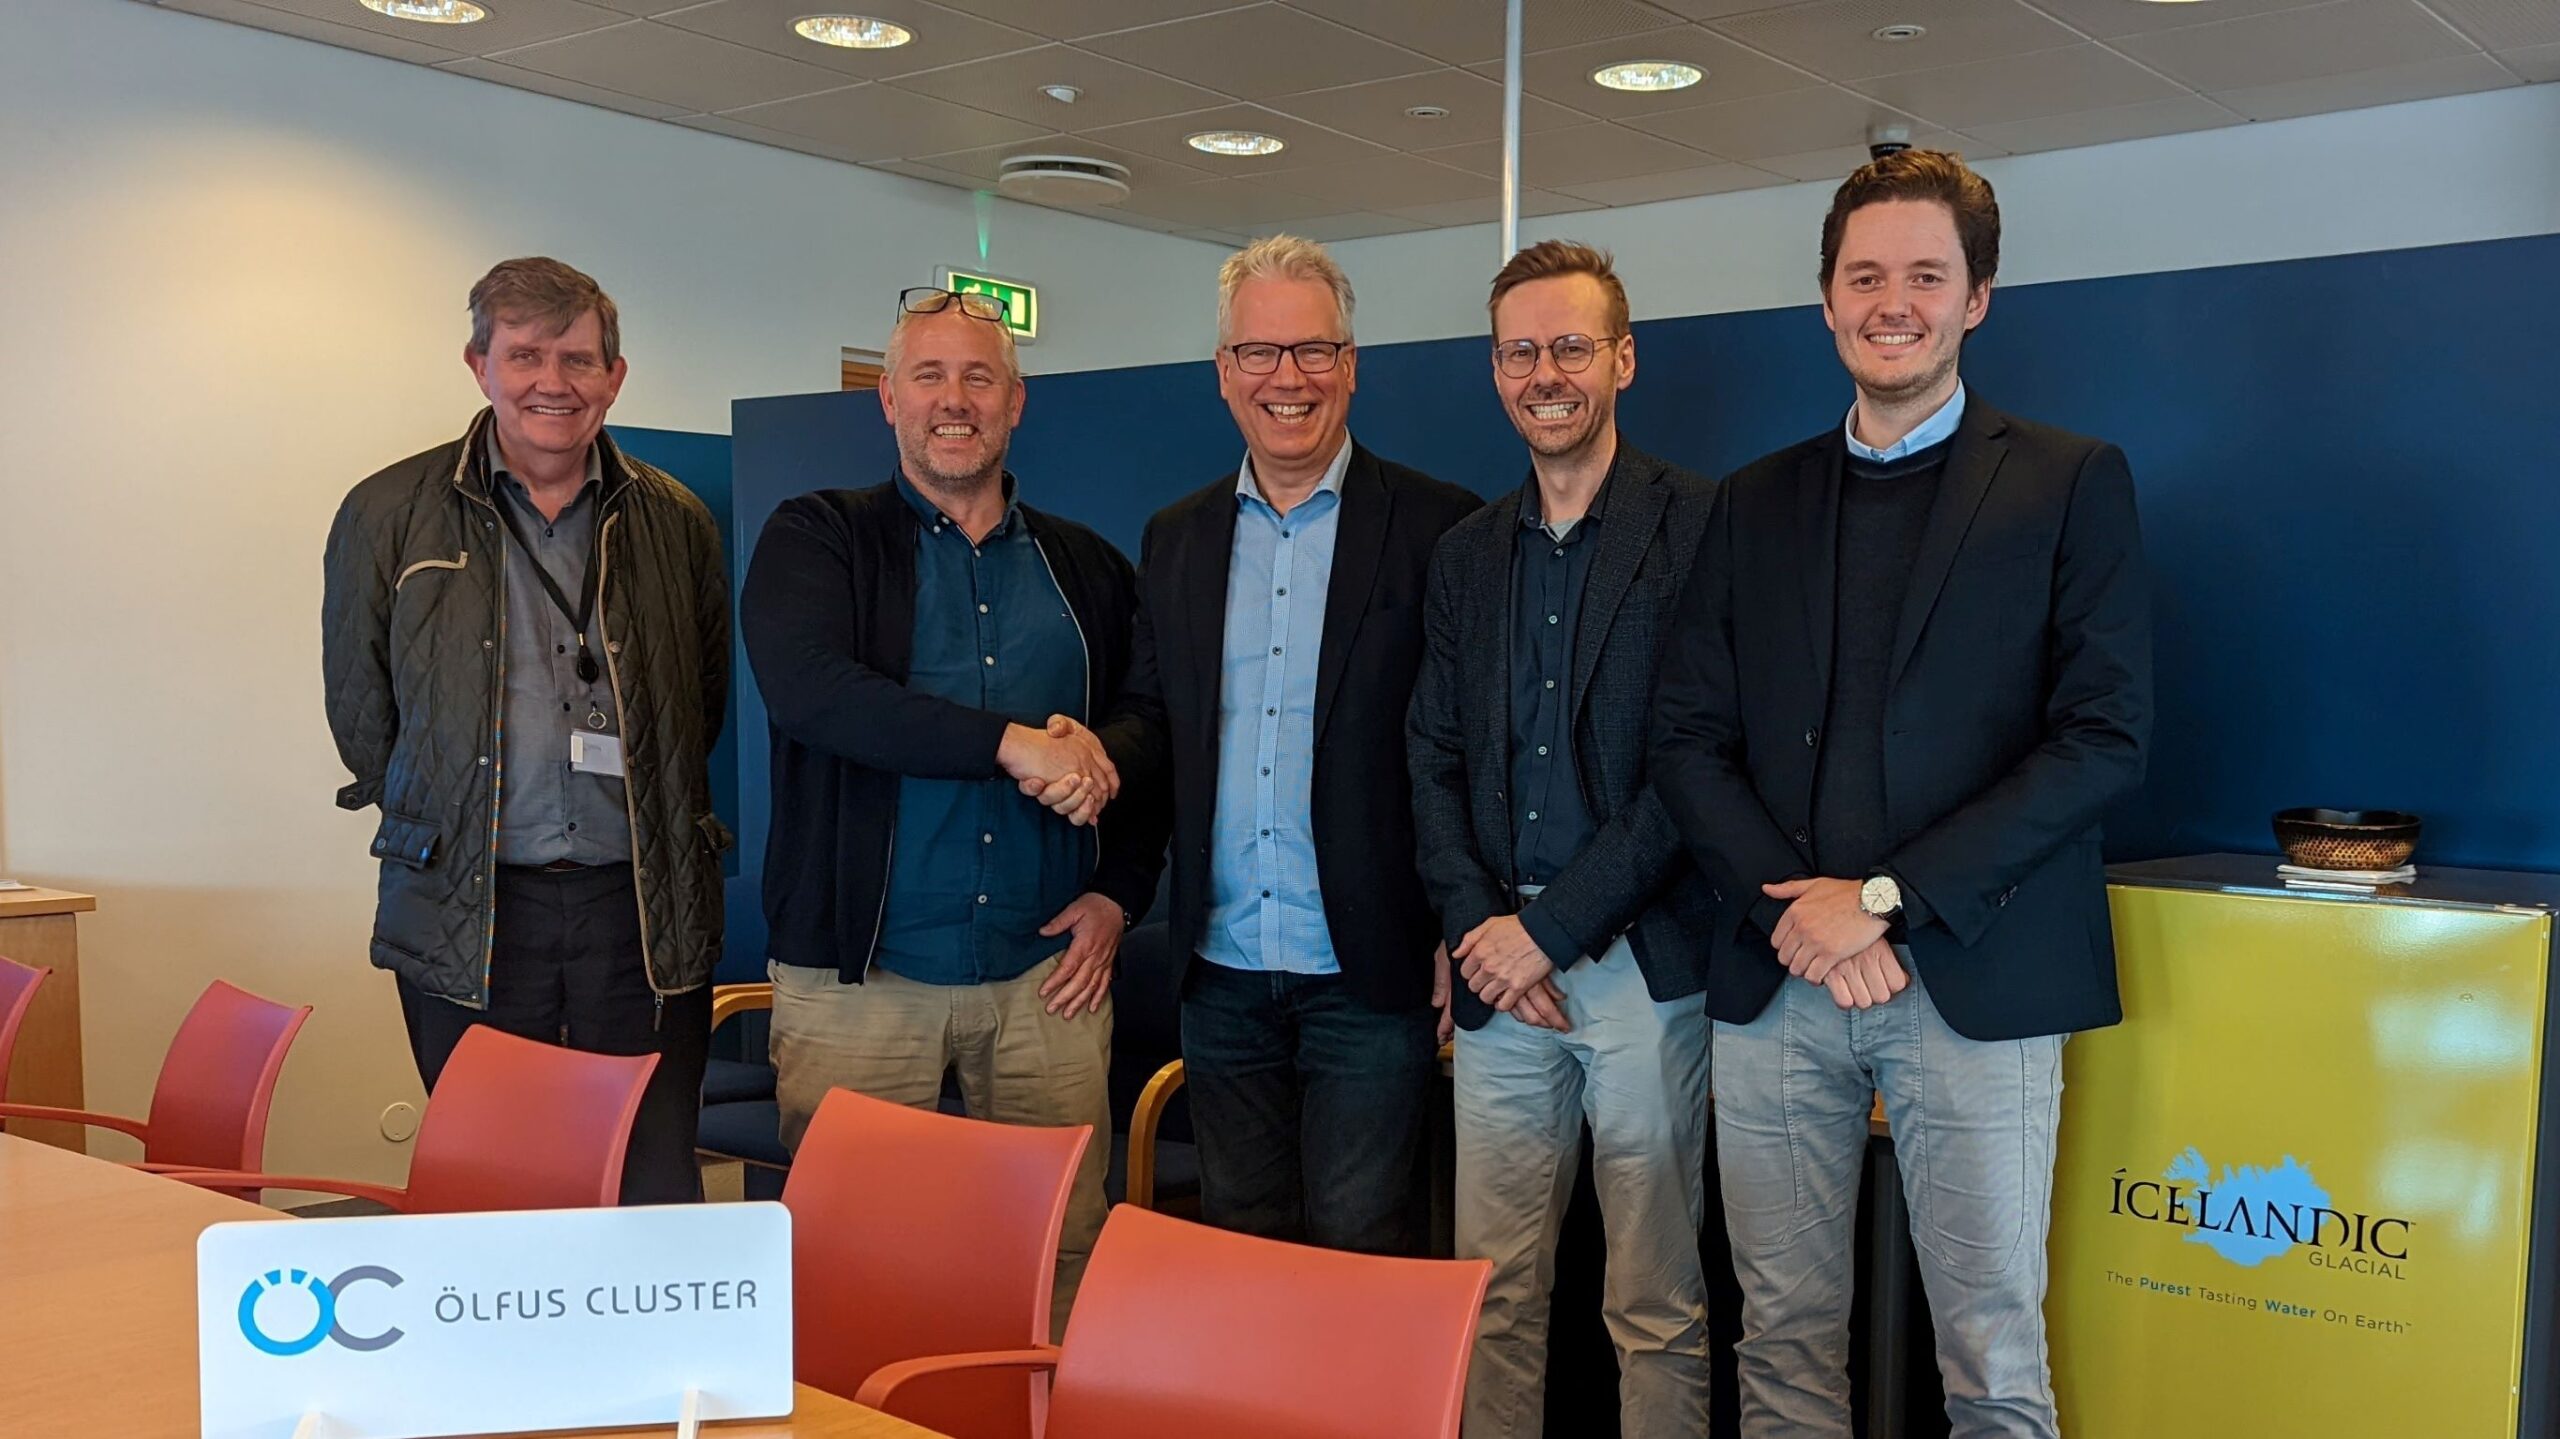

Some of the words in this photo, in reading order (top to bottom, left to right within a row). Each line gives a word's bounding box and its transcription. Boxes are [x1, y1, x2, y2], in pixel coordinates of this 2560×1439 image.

[2308, 1251, 2406, 1280] GLACIAL
[435, 1286, 567, 1323] ÖLFUS
[586, 1279, 758, 1315] CLUSTER
[2106, 1270, 2134, 1287] The
[2140, 1277, 2191, 1297] Purest
[2198, 1287, 2257, 1310] Tasting
[2265, 1299, 2317, 1319] Water
[2324, 1309, 2348, 1325] On
